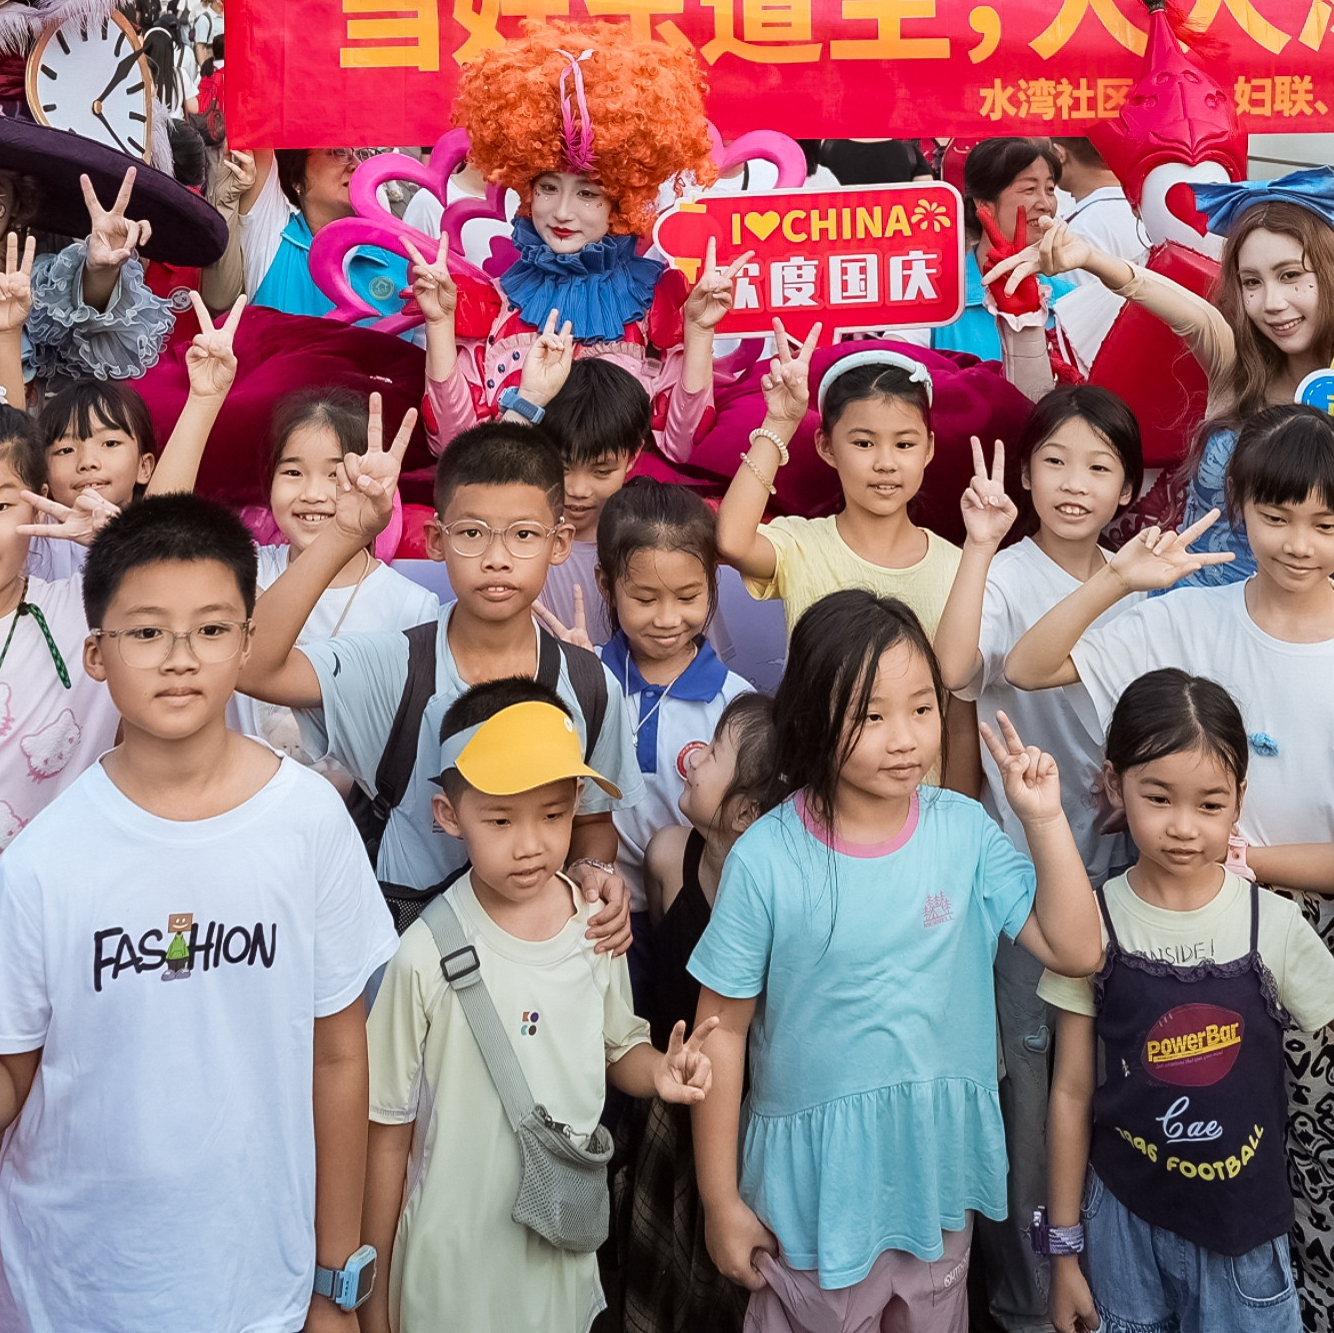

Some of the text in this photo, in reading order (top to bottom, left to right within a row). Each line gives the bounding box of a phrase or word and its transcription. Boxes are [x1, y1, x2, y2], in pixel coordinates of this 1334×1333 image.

[781, 204, 912, 243] CHINA
[93, 920, 277, 993] FASHION
[1166, 1123, 1265, 1182] FOOTBALL
